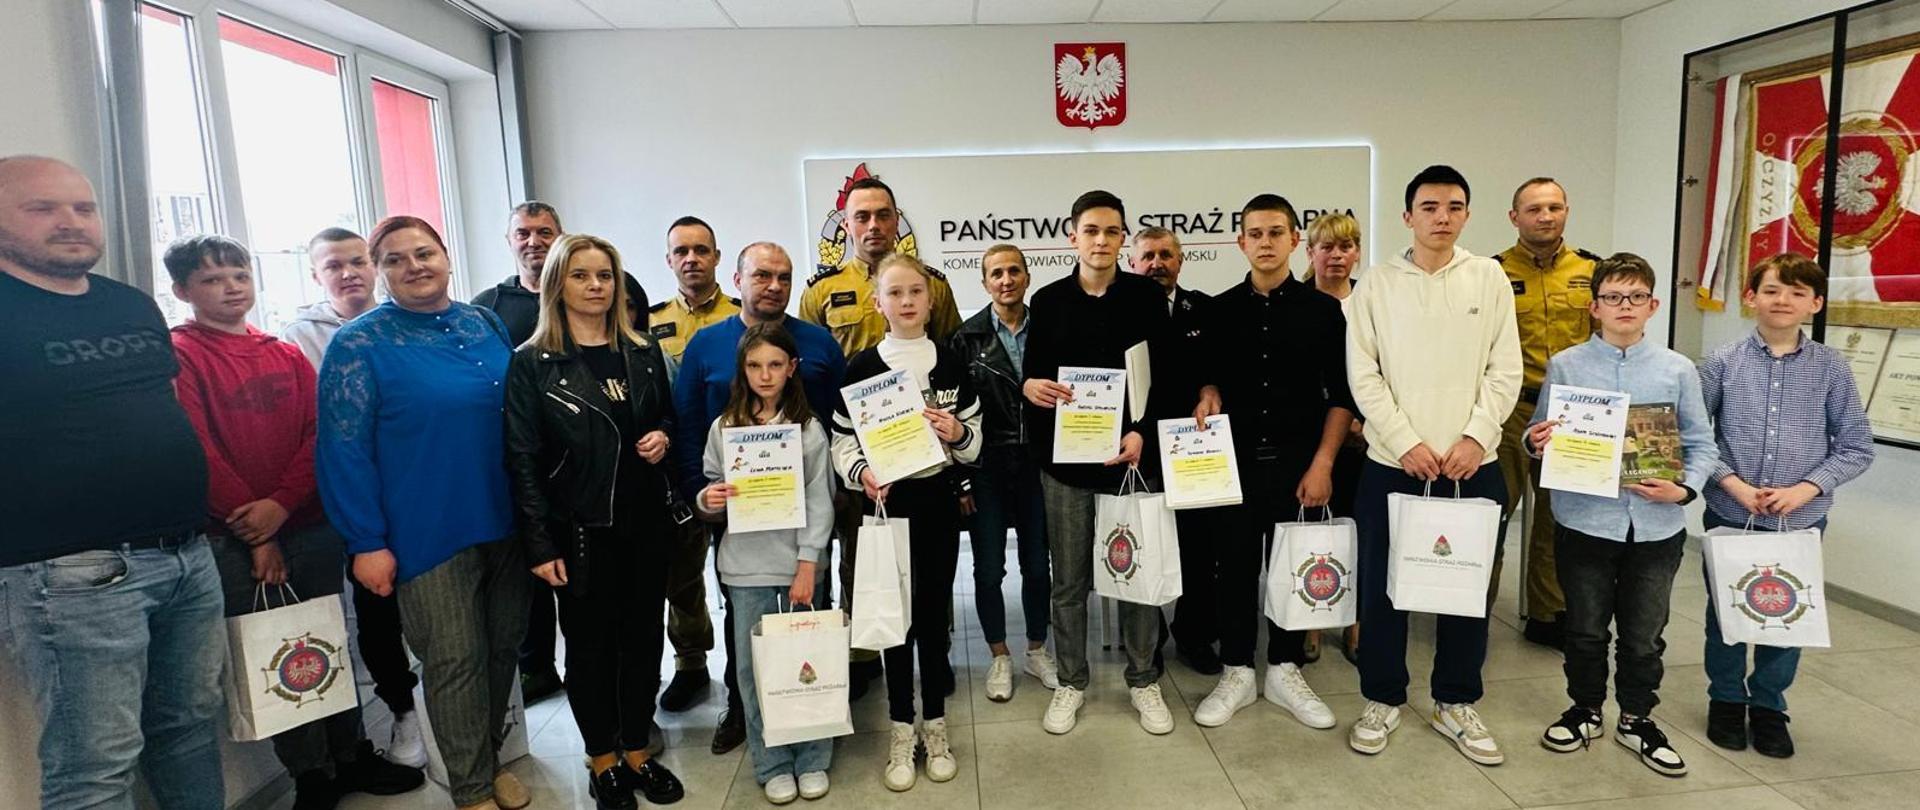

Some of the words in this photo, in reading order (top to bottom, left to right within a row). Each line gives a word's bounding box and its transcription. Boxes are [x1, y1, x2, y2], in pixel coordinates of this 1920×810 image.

[1138, 207, 1223, 235] STRAŻ
[1181, 250, 1217, 262] MSKU
[1074, 373, 1110, 383] DYPLOM
[861, 376, 898, 397] DYPLOM
[1569, 393, 1611, 406] DYPLOM
[1178, 423, 1212, 434] DYPLM
[742, 431, 783, 443] DYPLOM
